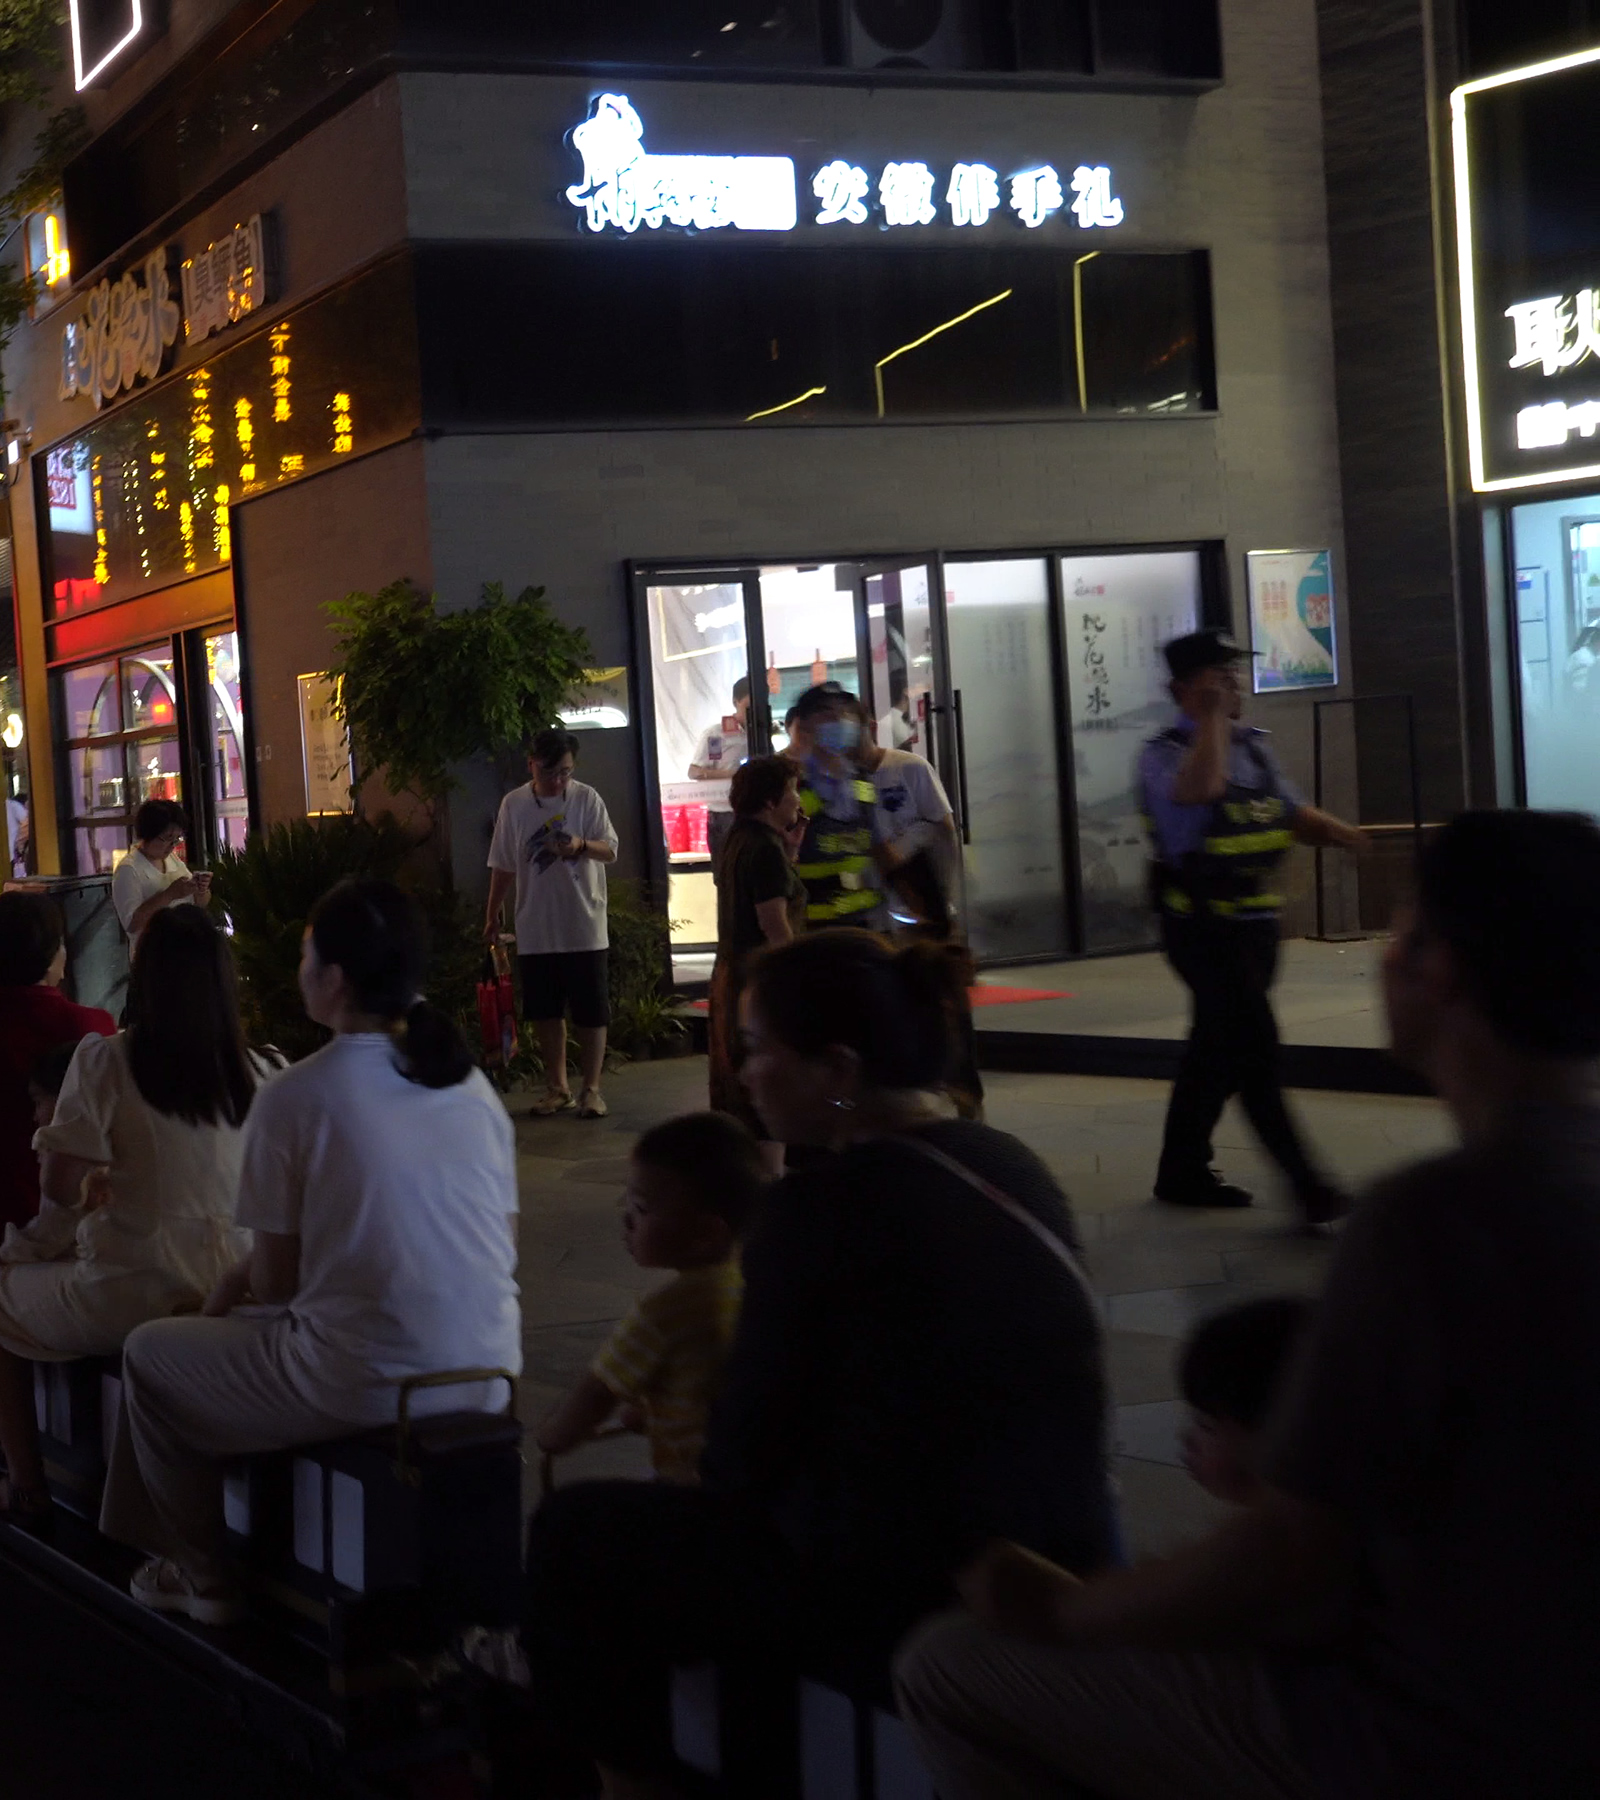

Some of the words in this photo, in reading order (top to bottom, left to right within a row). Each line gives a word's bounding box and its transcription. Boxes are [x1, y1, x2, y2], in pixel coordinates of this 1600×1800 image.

[811, 159, 1124, 229] 安徽伴手礼
